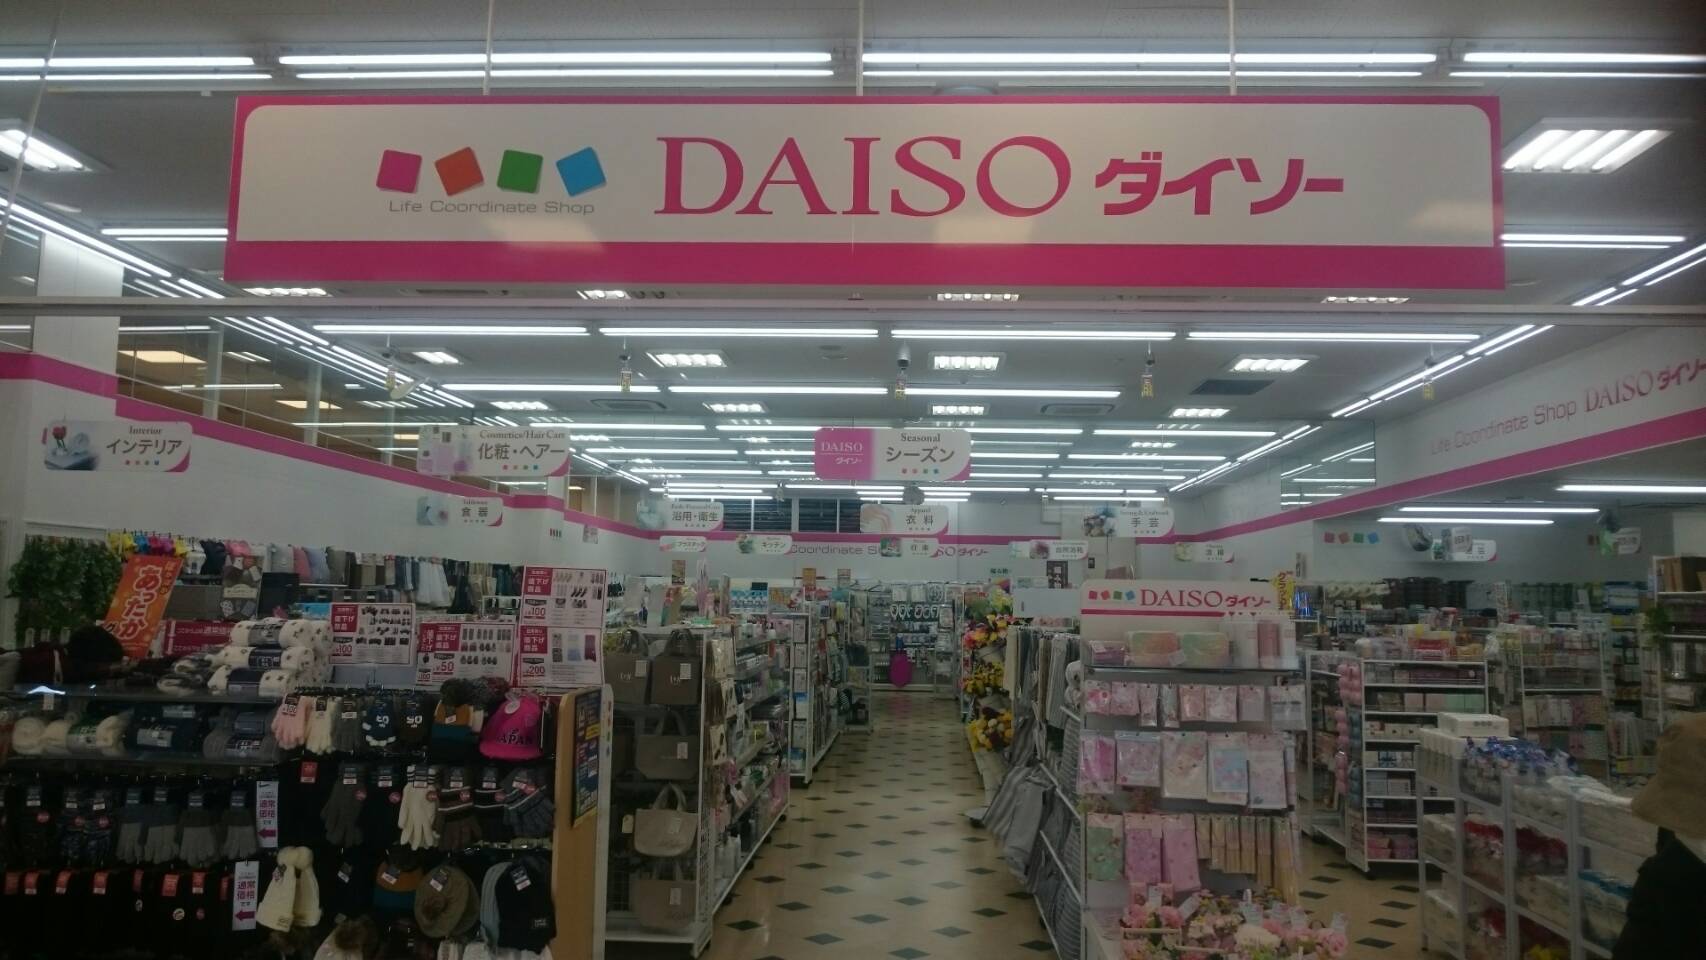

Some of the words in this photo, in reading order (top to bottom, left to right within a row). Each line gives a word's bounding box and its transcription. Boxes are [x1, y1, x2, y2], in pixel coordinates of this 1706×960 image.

[654, 135, 1071, 217] DAISO
[1095, 151, 1344, 216] ダイソー
[389, 200, 423, 213] Life
[430, 200, 538, 214] Coordinate
[544, 201, 596, 216] Shop
[1534, 400, 1577, 426] Shop
[1585, 369, 1655, 412] DAISO
[129, 426, 163, 436] Interior
[479, 429, 544, 441] Cosmetics/Hair
[547, 430, 565, 440] Care
[901, 432, 941, 443] Seasonal
[106, 438, 183, 455] インテリア
[478, 443, 565, 461] 化粧・ヘアー
[821, 442, 863, 453] DAISO
[886, 446, 955, 463] シーズン
[461, 507, 489, 518] 食器
[671, 511, 720, 522] 浴用・衛生
[905, 514, 934, 526] 衣料
[1130, 517, 1160, 528] 手芸
[790, 543, 865, 556] Coordinate
[957, 546, 989, 557] ダイソー
[118, 565, 163, 639] あったか
[1140, 589, 1223, 608] DAISO
[1225, 595, 1271, 608] ダイソー
[238, 880, 256, 890] 通常
